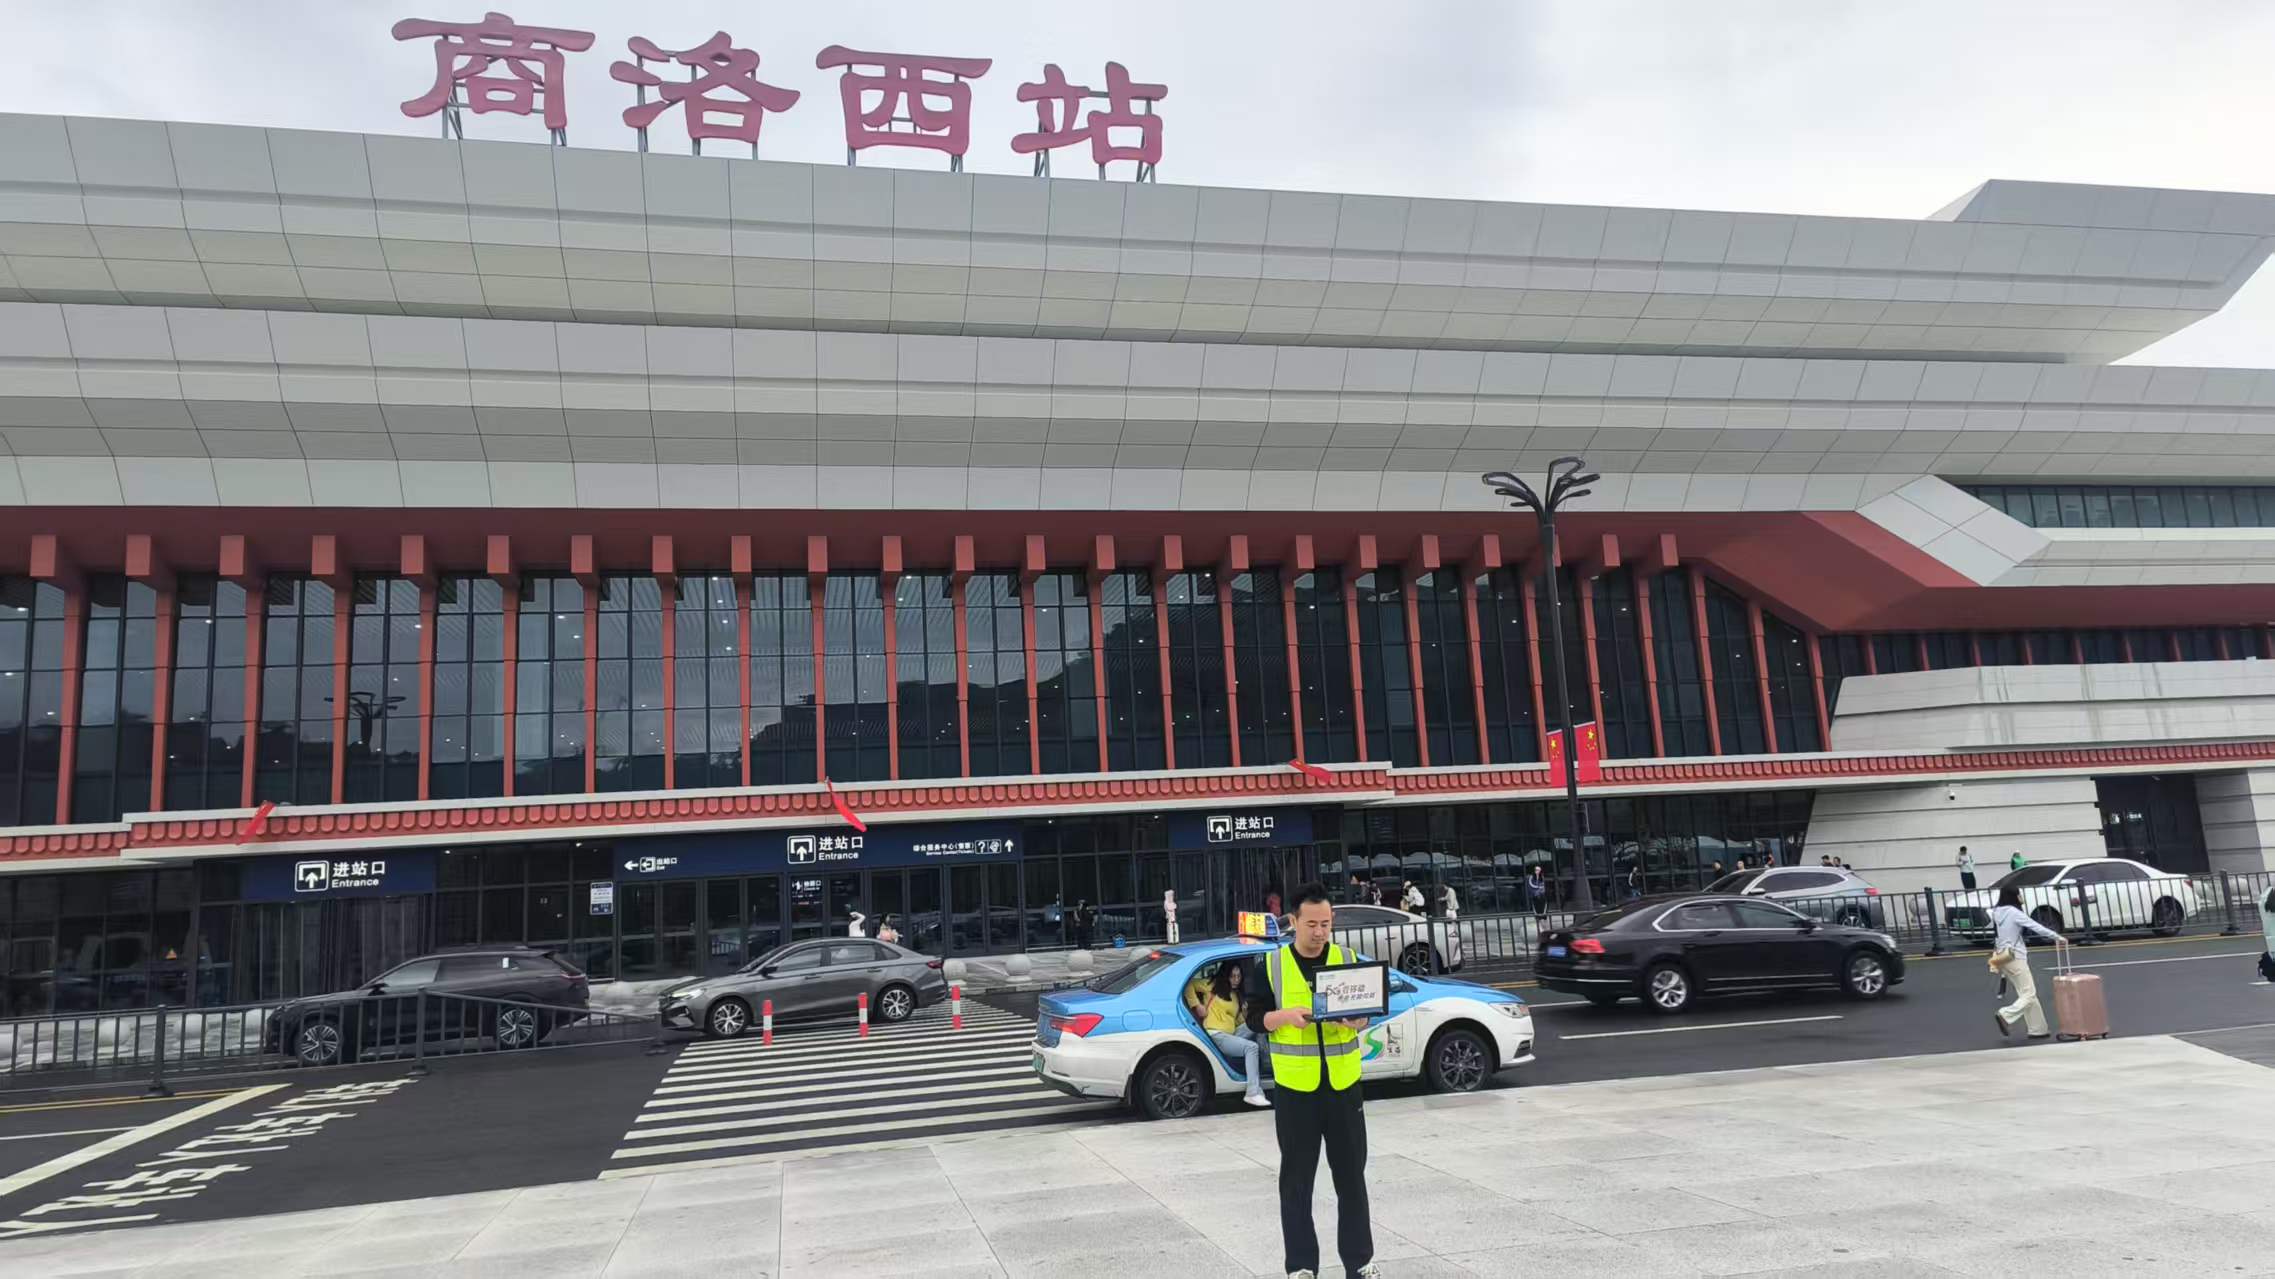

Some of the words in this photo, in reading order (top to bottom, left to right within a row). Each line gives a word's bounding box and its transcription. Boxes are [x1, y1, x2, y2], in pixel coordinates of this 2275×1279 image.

[391, 11, 1168, 164] 商洛西站
[1234, 816, 1274, 830] 进站口
[1235, 831, 1270, 839] Entrance
[818, 836, 863, 851] 进站口
[818, 852, 859, 861] Entrance
[332, 861, 385, 877] 进站口
[331, 879, 379, 888] Entrance
